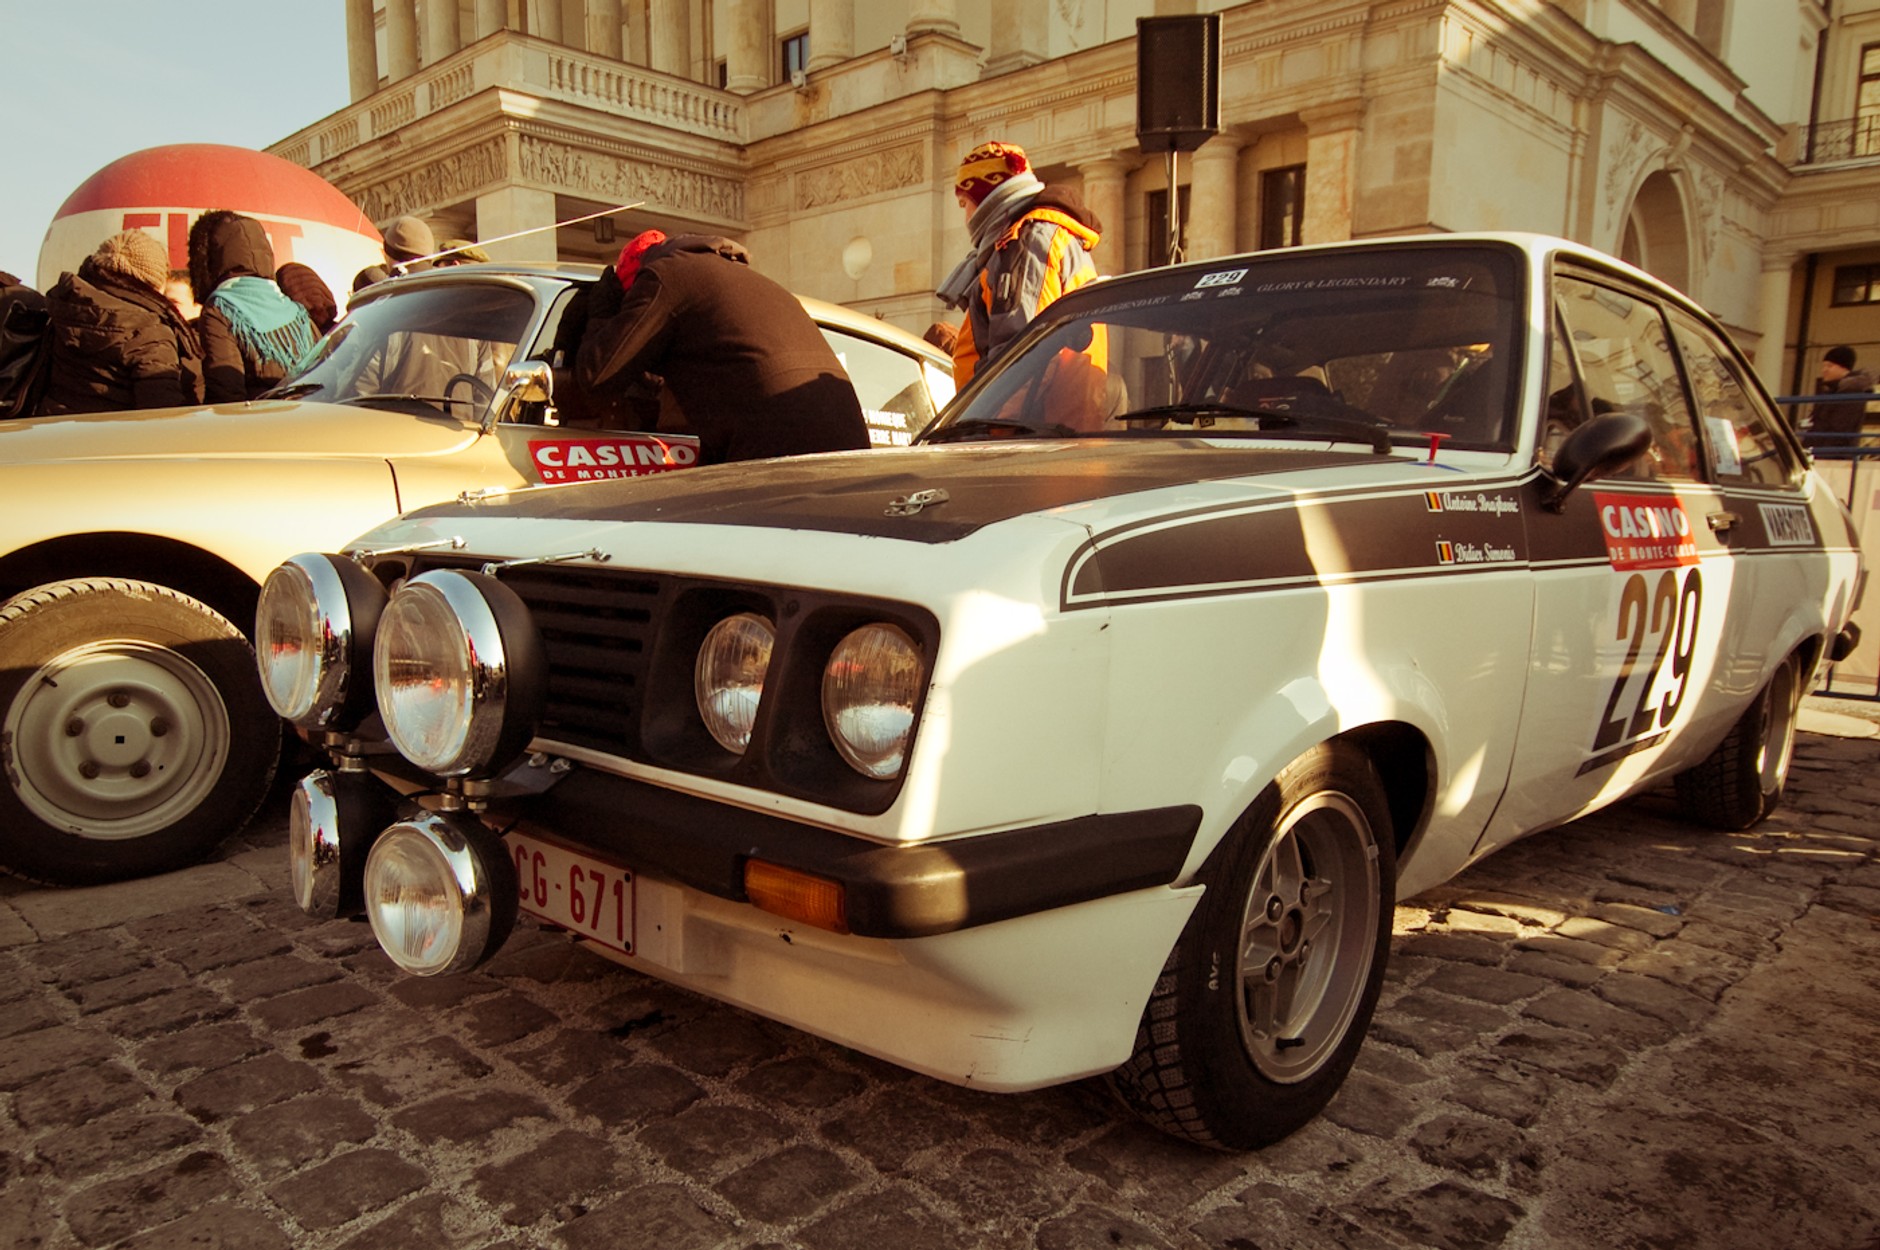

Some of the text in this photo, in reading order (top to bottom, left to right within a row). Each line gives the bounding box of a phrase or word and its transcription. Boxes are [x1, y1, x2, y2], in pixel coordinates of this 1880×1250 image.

[122, 213, 304, 271] FIT
[1200, 271, 1242, 286] 229
[1257, 276, 1411, 292] GLORY & LEGENDARY
[536, 445, 696, 467] CASINO
[543, 469, 667, 479] DE MONTE-C
[1602, 505, 1689, 538] CASINO
[1454, 543, 1484, 562] Didier
[1609, 546, 1625, 561] DE
[1591, 567, 1702, 753] 229
